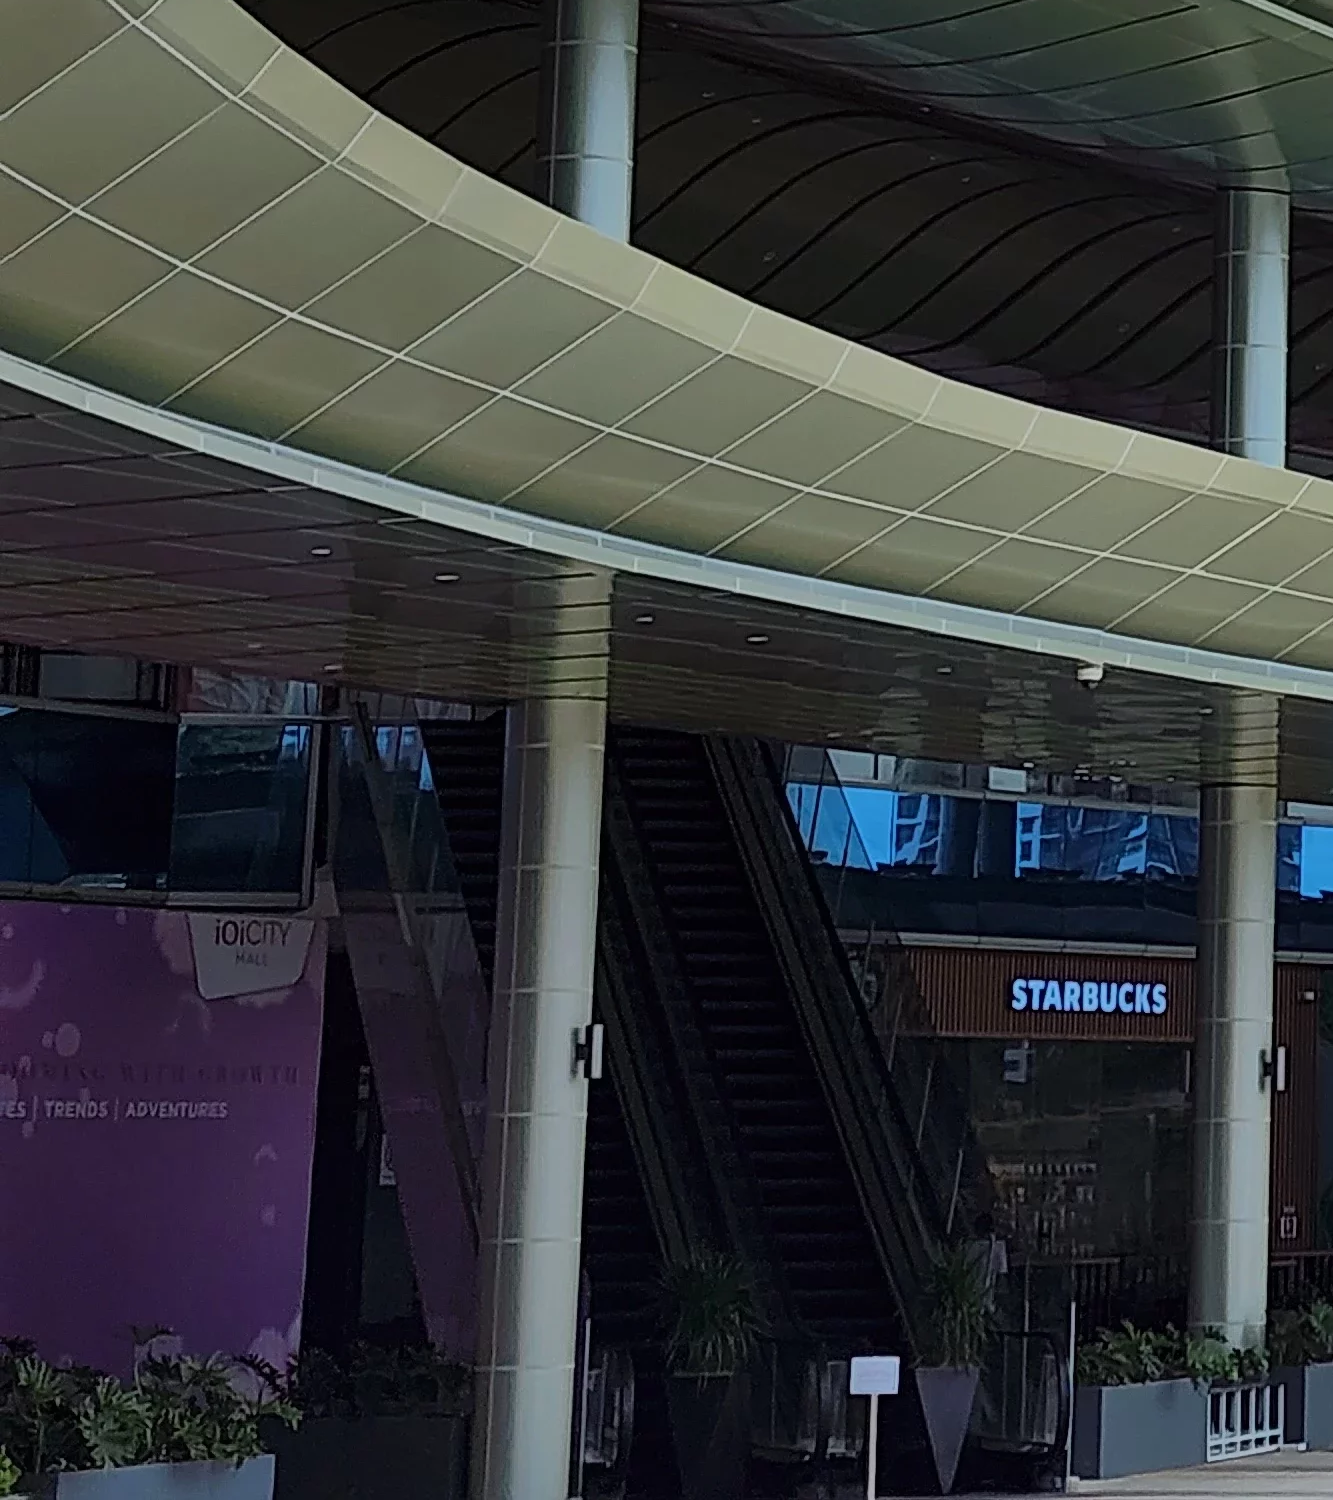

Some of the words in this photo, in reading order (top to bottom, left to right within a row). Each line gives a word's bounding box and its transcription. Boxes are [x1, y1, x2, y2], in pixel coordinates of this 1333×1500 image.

[1011, 978, 1167, 1014] STARBUCKS
[44, 1099, 109, 1119] TRENDS
[125, 1101, 228, 1119] ADVENTURES
